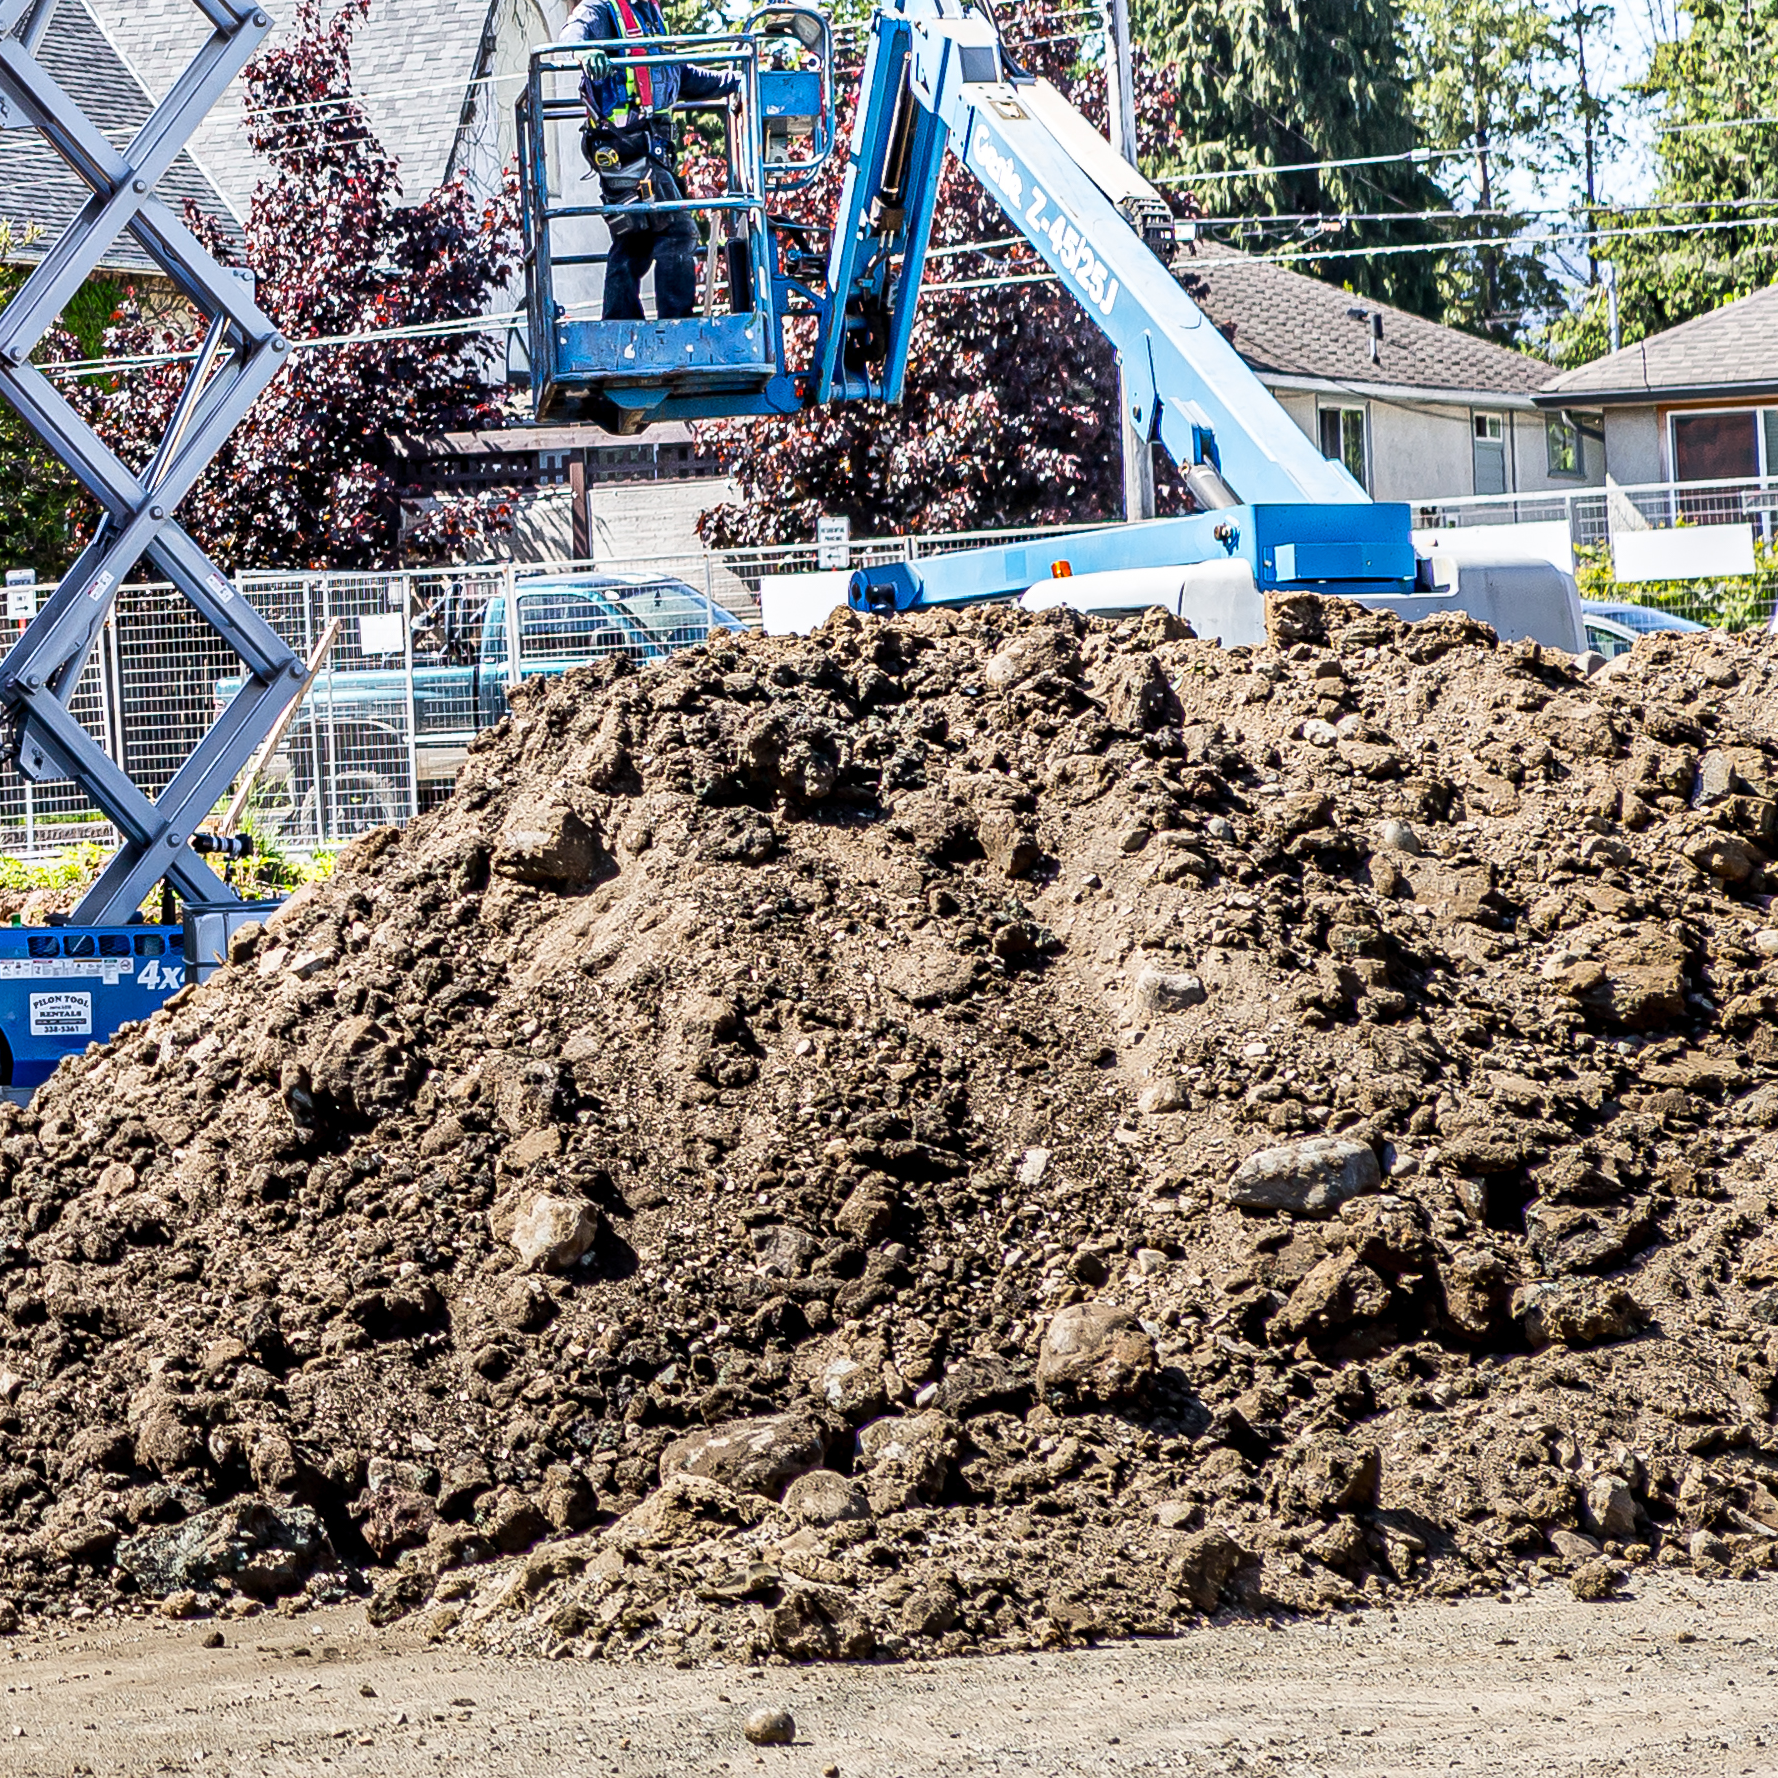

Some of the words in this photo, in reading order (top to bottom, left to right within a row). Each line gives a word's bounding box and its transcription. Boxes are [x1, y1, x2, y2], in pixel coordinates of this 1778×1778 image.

[973, 124, 1023, 211] Genie
[137, 960, 185, 990] 4x
[33, 995, 62, 1009] PILON
[65, 995, 89, 1008] TOOL
